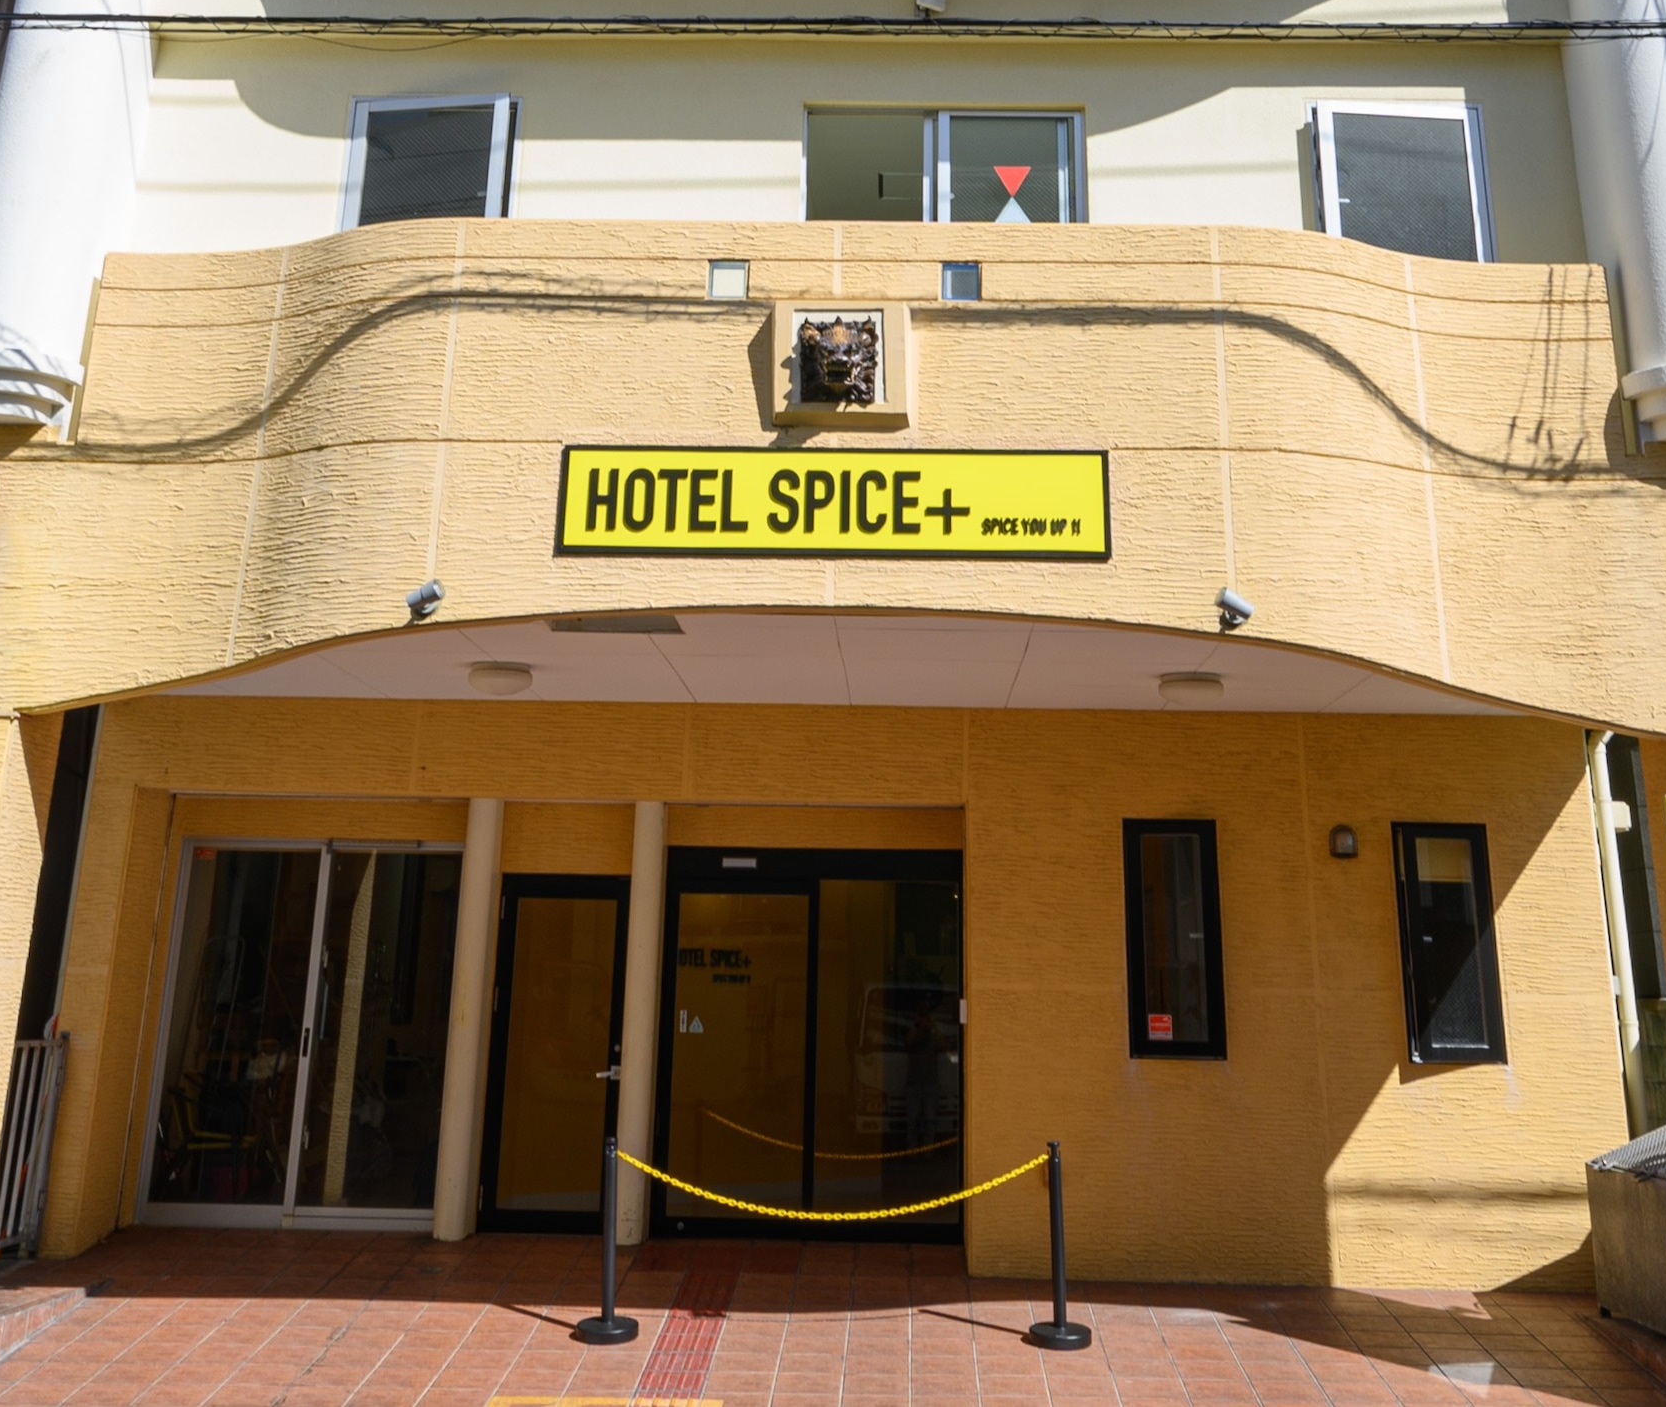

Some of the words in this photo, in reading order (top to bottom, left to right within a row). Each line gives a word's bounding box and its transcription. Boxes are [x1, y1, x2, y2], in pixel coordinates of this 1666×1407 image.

[585, 468, 749, 533] HOTEL
[767, 469, 970, 535] SPICE+
[981, 517, 1019, 536] SPICE
[1021, 518, 1047, 536] YOU
[1050, 518, 1067, 536] UP
